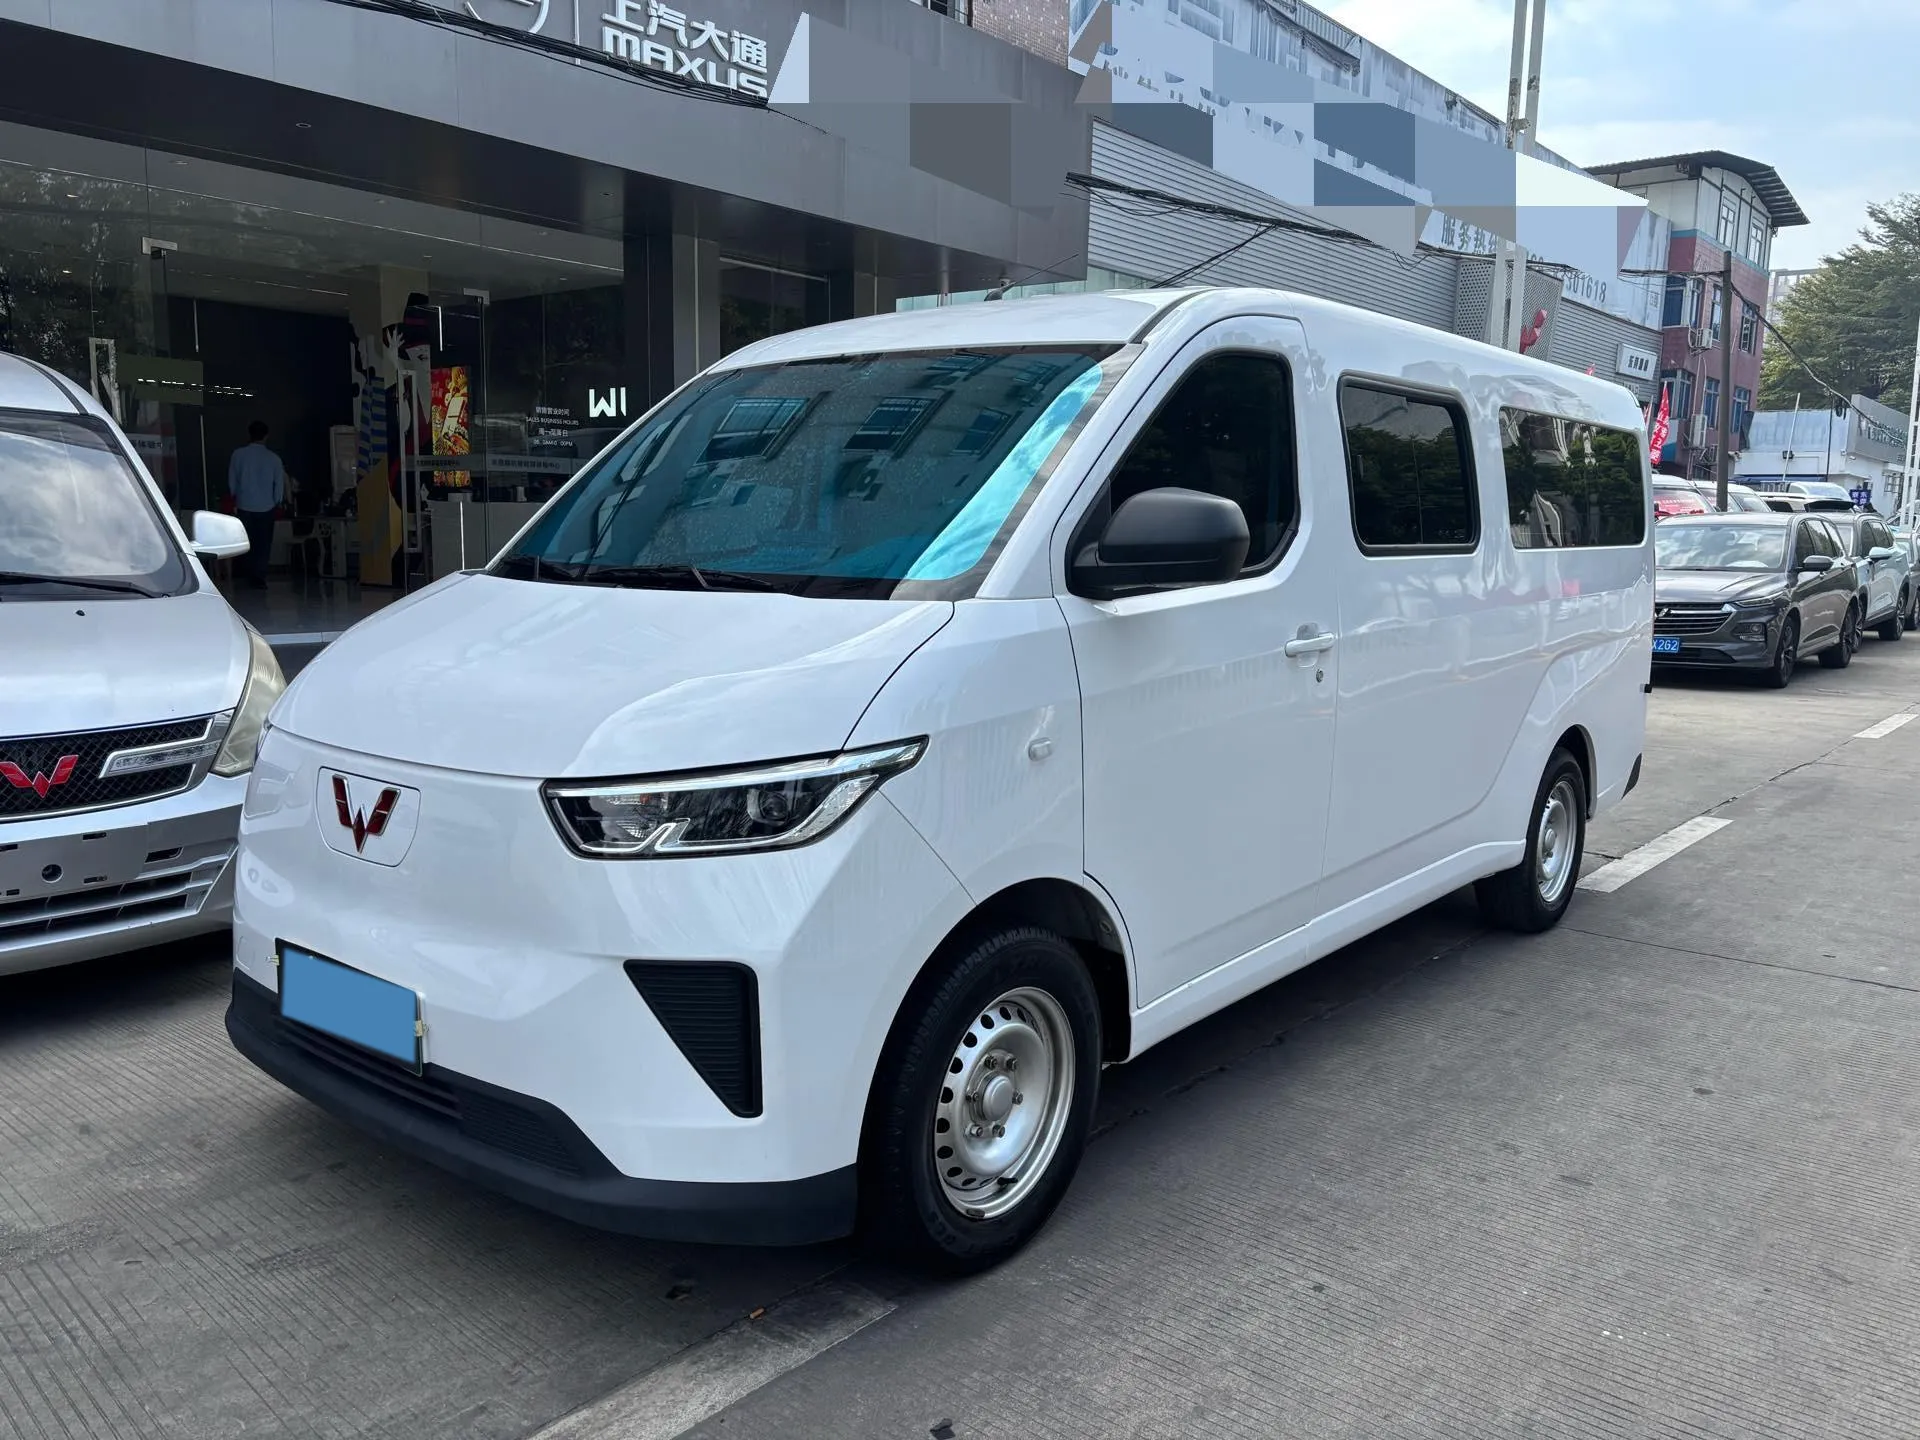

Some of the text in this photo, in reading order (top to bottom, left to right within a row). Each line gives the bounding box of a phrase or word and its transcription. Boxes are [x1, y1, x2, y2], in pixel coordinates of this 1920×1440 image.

[602, 0, 767, 73] 上汽大通
[603, 27, 768, 98] MAXUS
